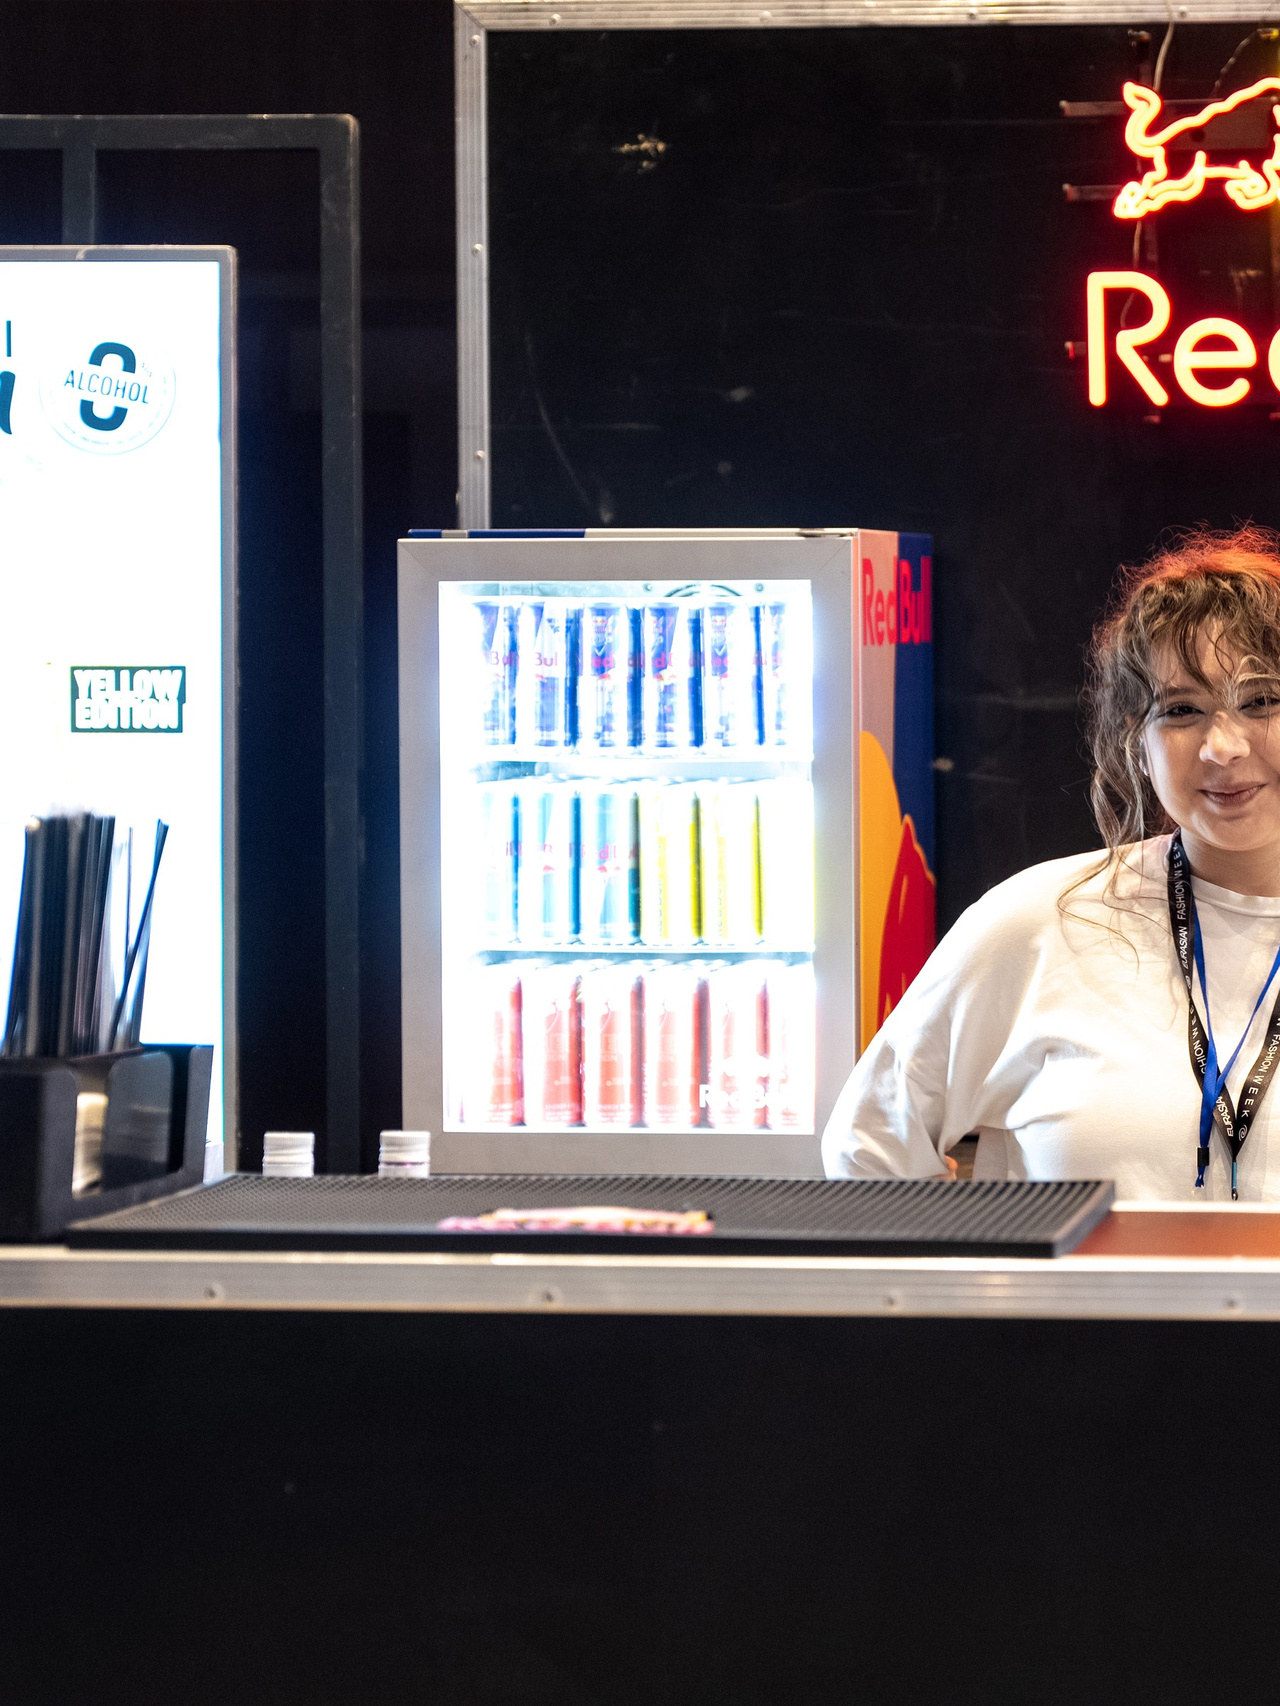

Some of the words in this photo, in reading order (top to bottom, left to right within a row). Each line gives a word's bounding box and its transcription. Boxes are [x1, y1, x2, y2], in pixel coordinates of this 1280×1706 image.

[64, 370, 149, 404] ALCOHOL
[862, 556, 898, 647] Red
[901, 556, 932, 646] Bull
[73, 669, 183, 701] YELLOW
[75, 697, 179, 730] EDITION
[1175, 879, 1187, 920] FASHION
[1241, 1074, 1265, 1118] WEEK
